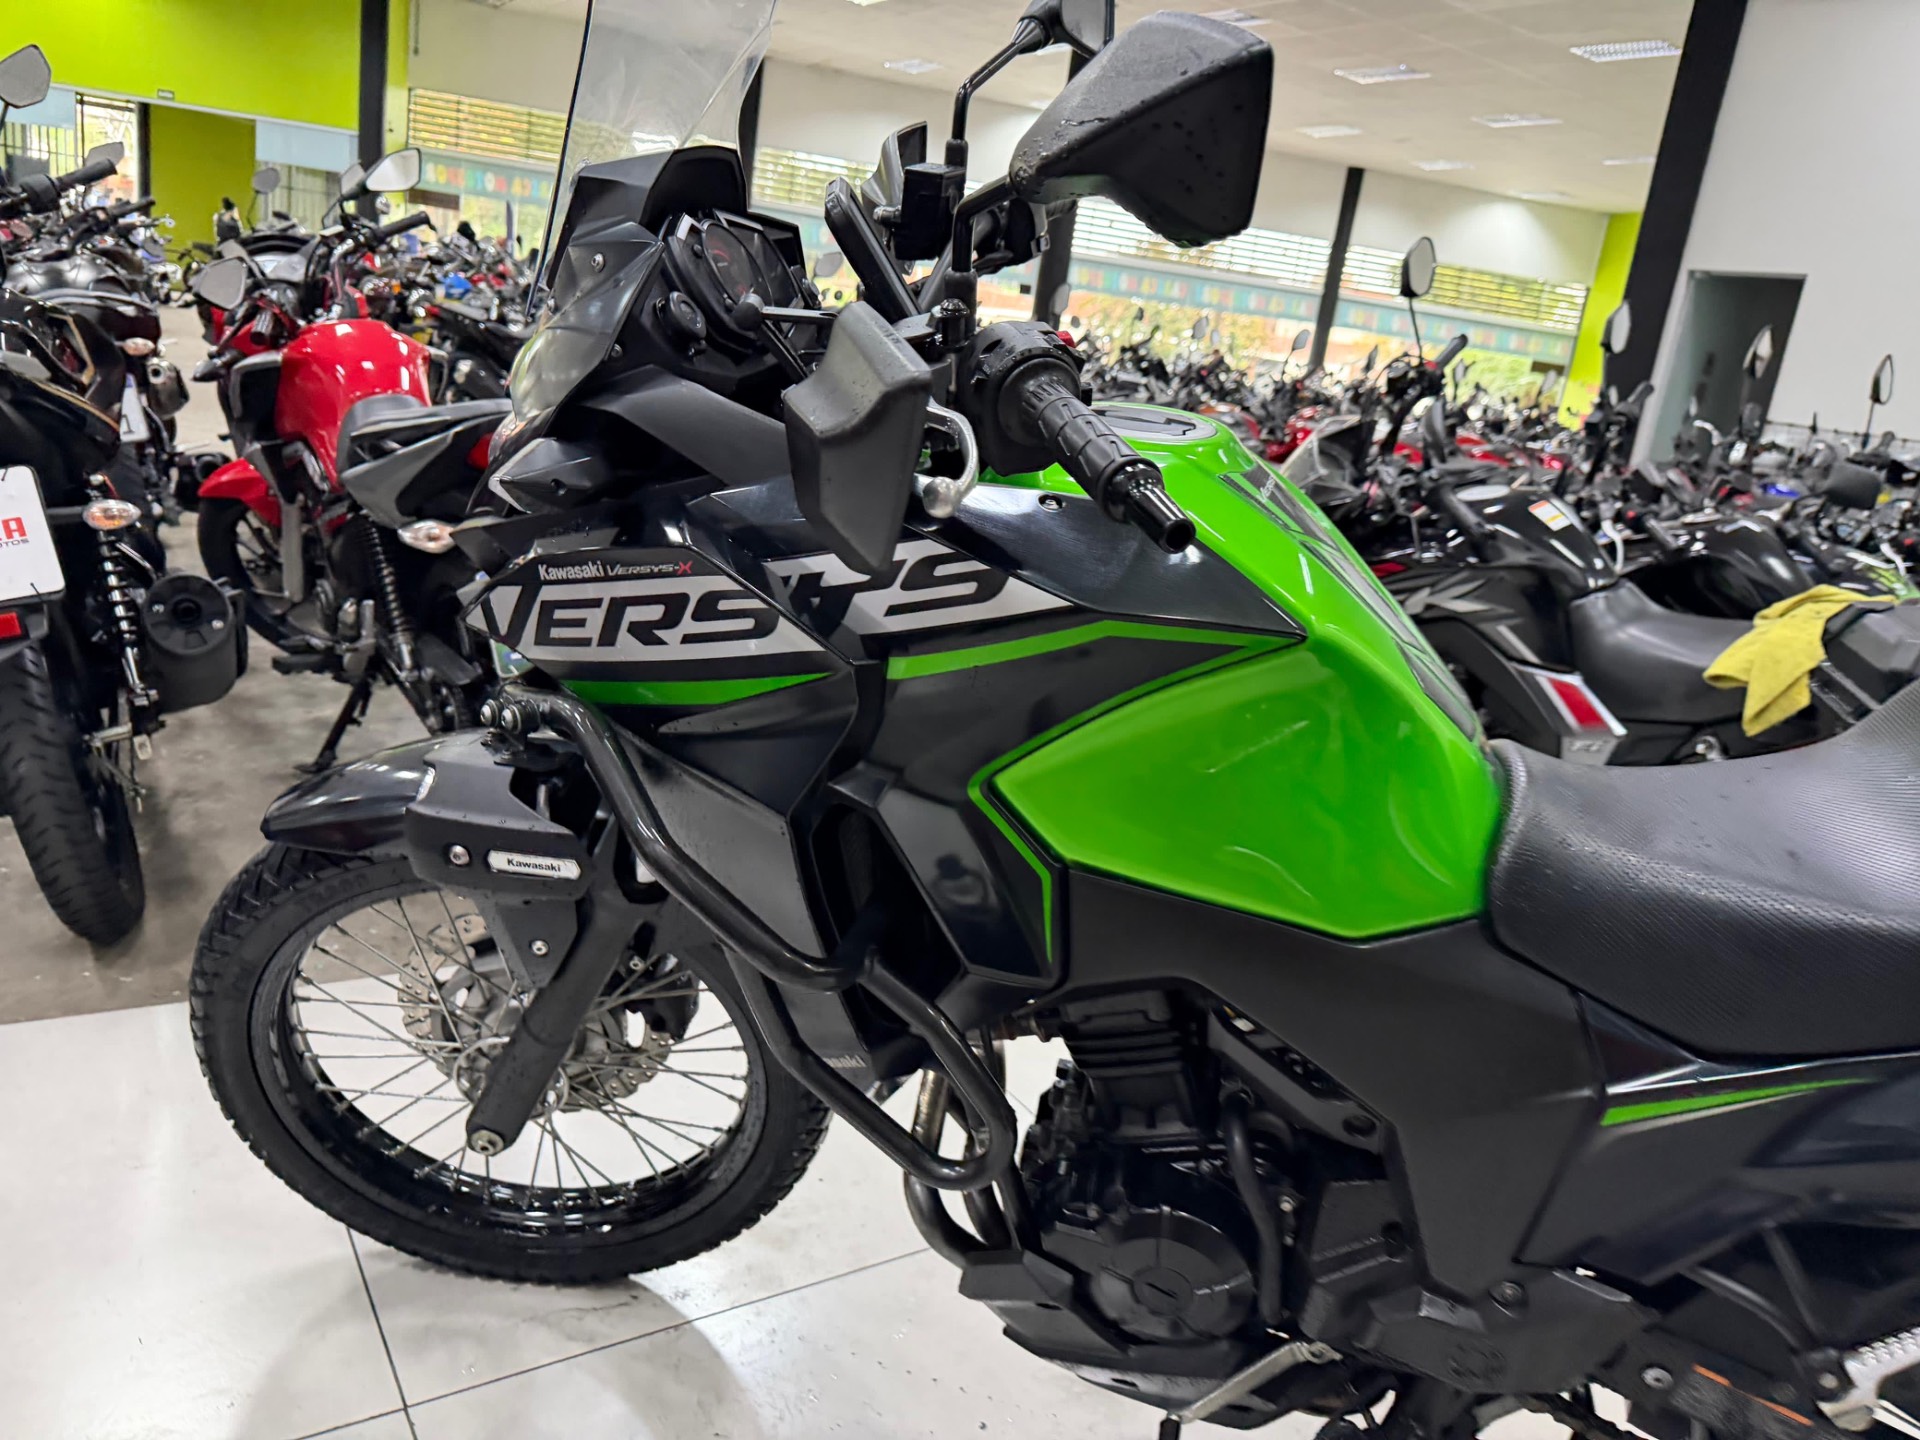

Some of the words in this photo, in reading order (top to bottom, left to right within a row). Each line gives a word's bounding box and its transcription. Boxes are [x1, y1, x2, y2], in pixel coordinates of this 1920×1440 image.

[538, 560, 605, 580] Kawasaki
[607, 560, 693, 576] VERSYS-X
[507, 857, 561, 872] Kawasaki
